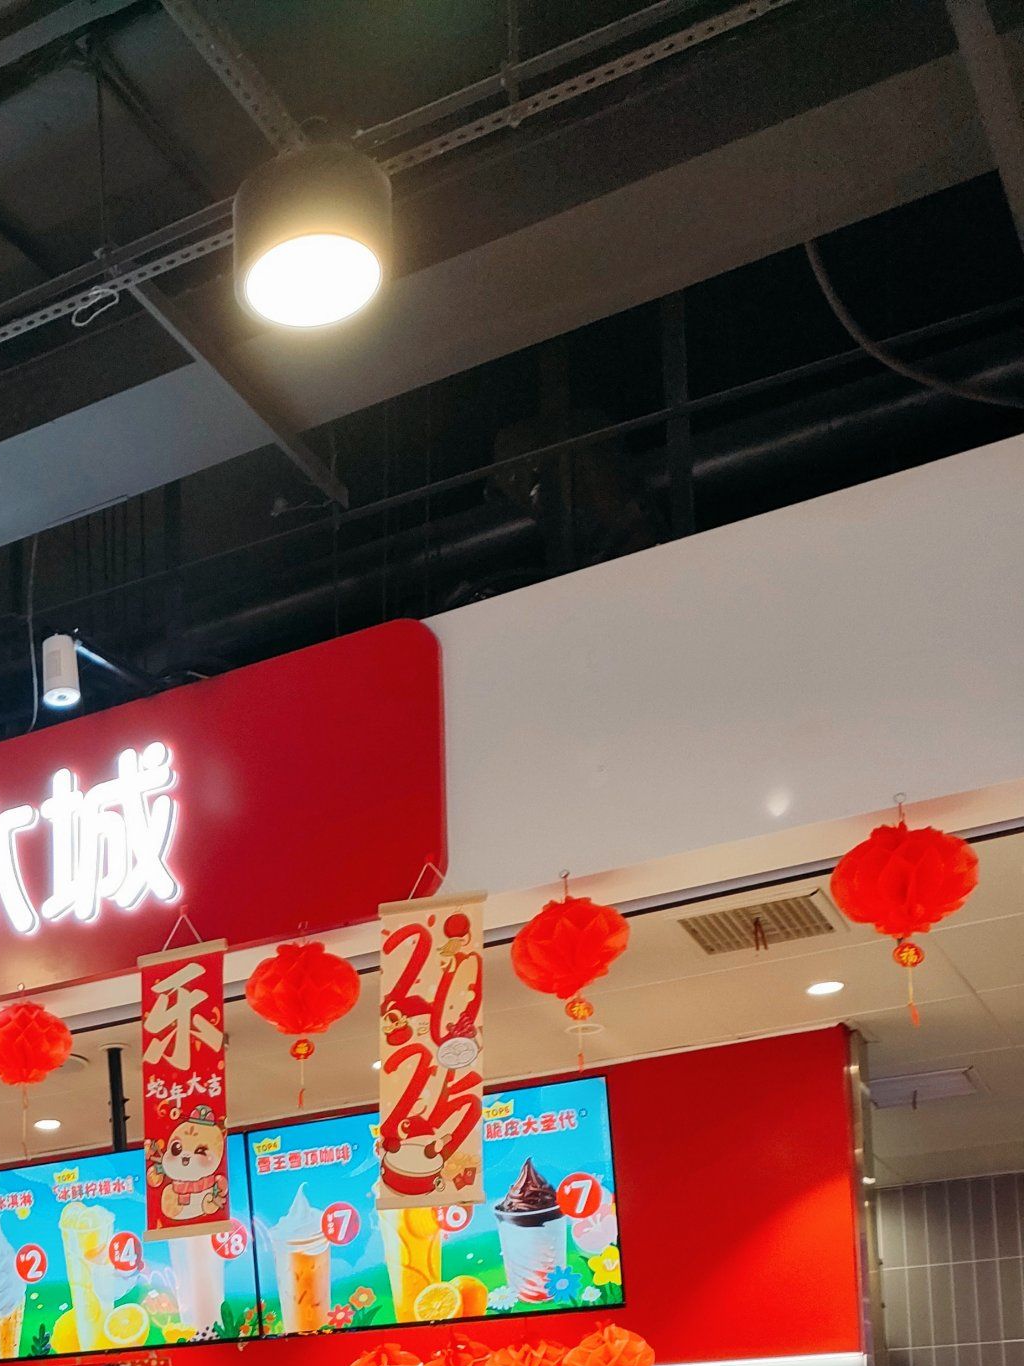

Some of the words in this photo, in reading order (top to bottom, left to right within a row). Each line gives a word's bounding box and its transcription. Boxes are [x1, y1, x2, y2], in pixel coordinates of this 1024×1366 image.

[143, 963, 223, 1070] 乐
[146, 1072, 222, 1108] 蛇年大吉
[485, 1111, 576, 1140] 脆皮大圣代
[58, 1182, 126, 1201] 冰鲜柠檬水
